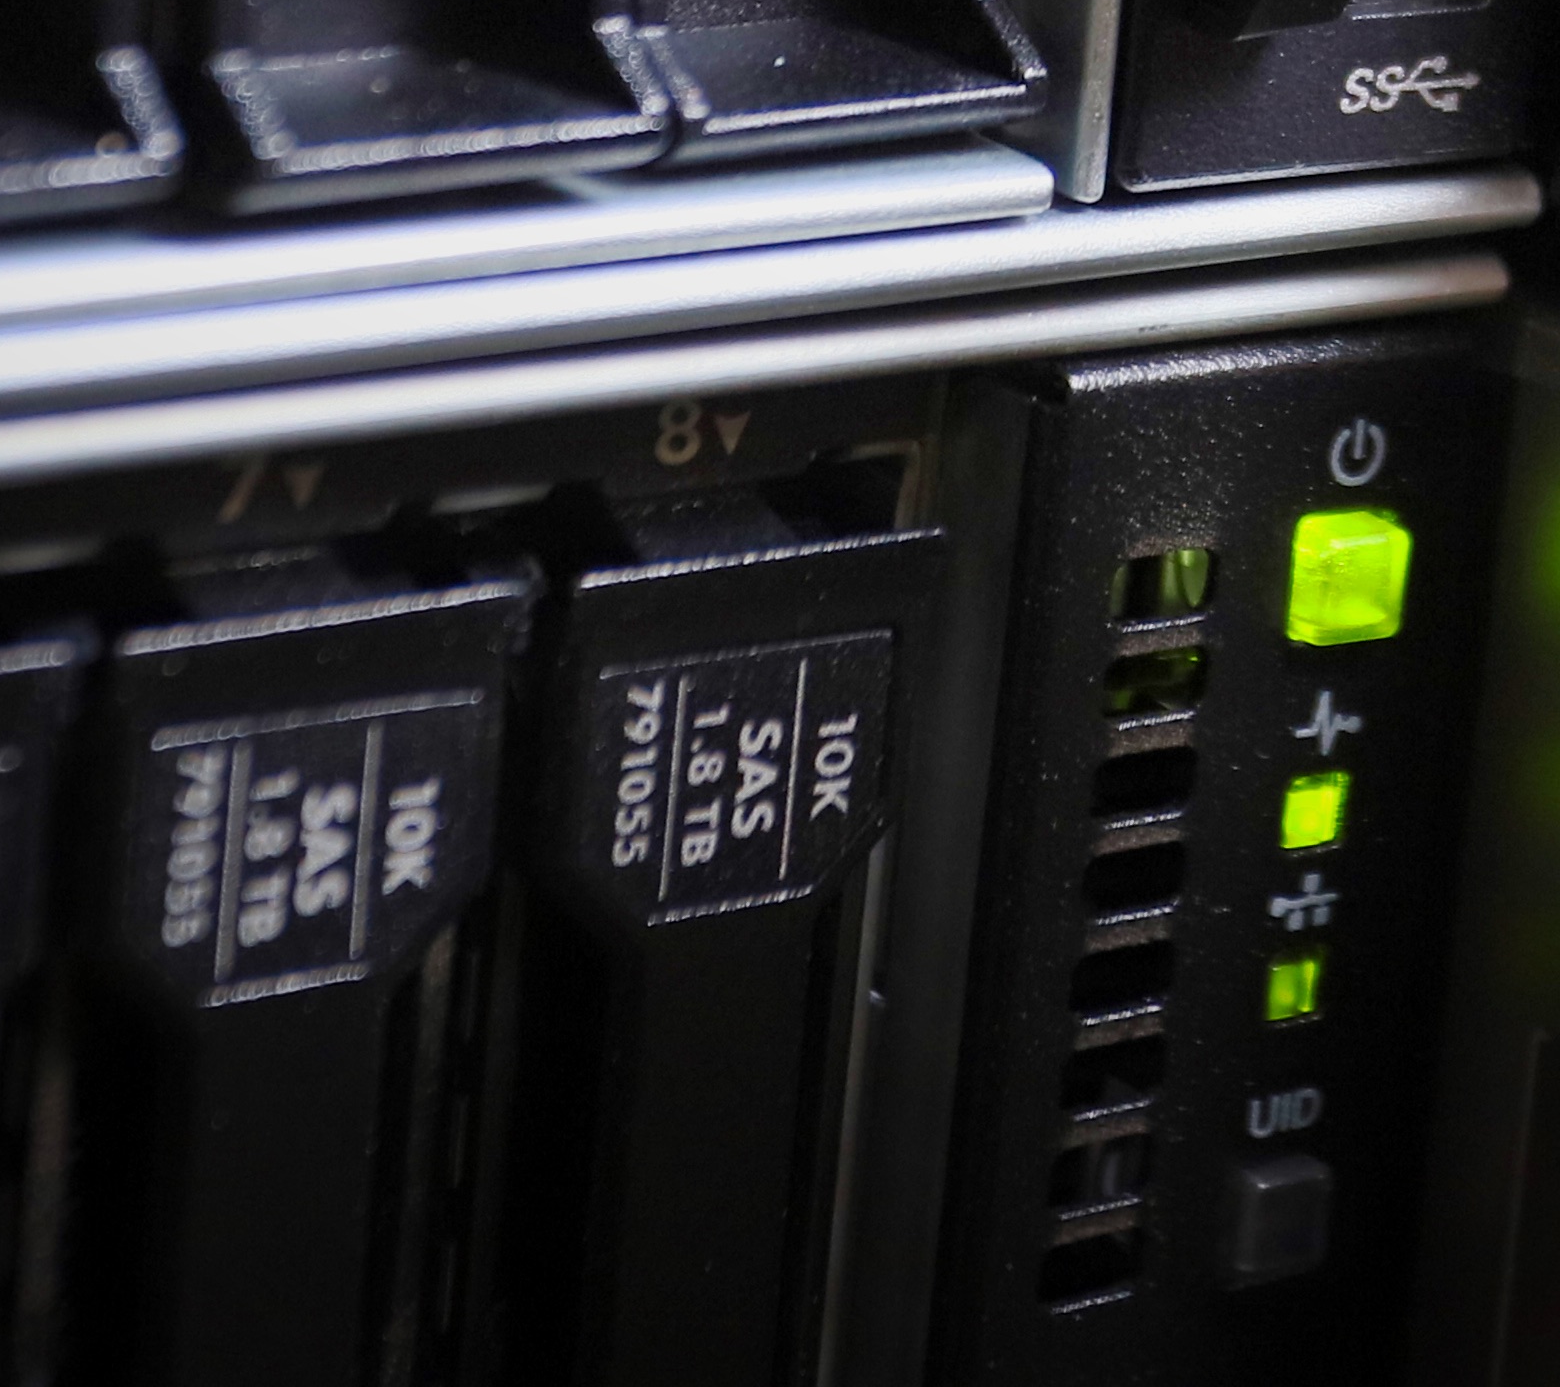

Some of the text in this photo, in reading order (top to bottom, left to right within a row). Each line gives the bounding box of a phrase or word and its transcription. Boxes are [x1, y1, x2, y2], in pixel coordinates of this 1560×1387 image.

[653, 399, 702, 467] 8
[611, 679, 665, 868] 791055
[680, 702, 731, 868] 1.8 TB
[730, 718, 783, 840] SAS
[809, 712, 858, 821] 10K
[294, 781, 359, 917] SAS
[382, 777, 441, 896] 10K
[238, 865, 290, 948] TB
[1248, 1088, 1323, 1139] UID
